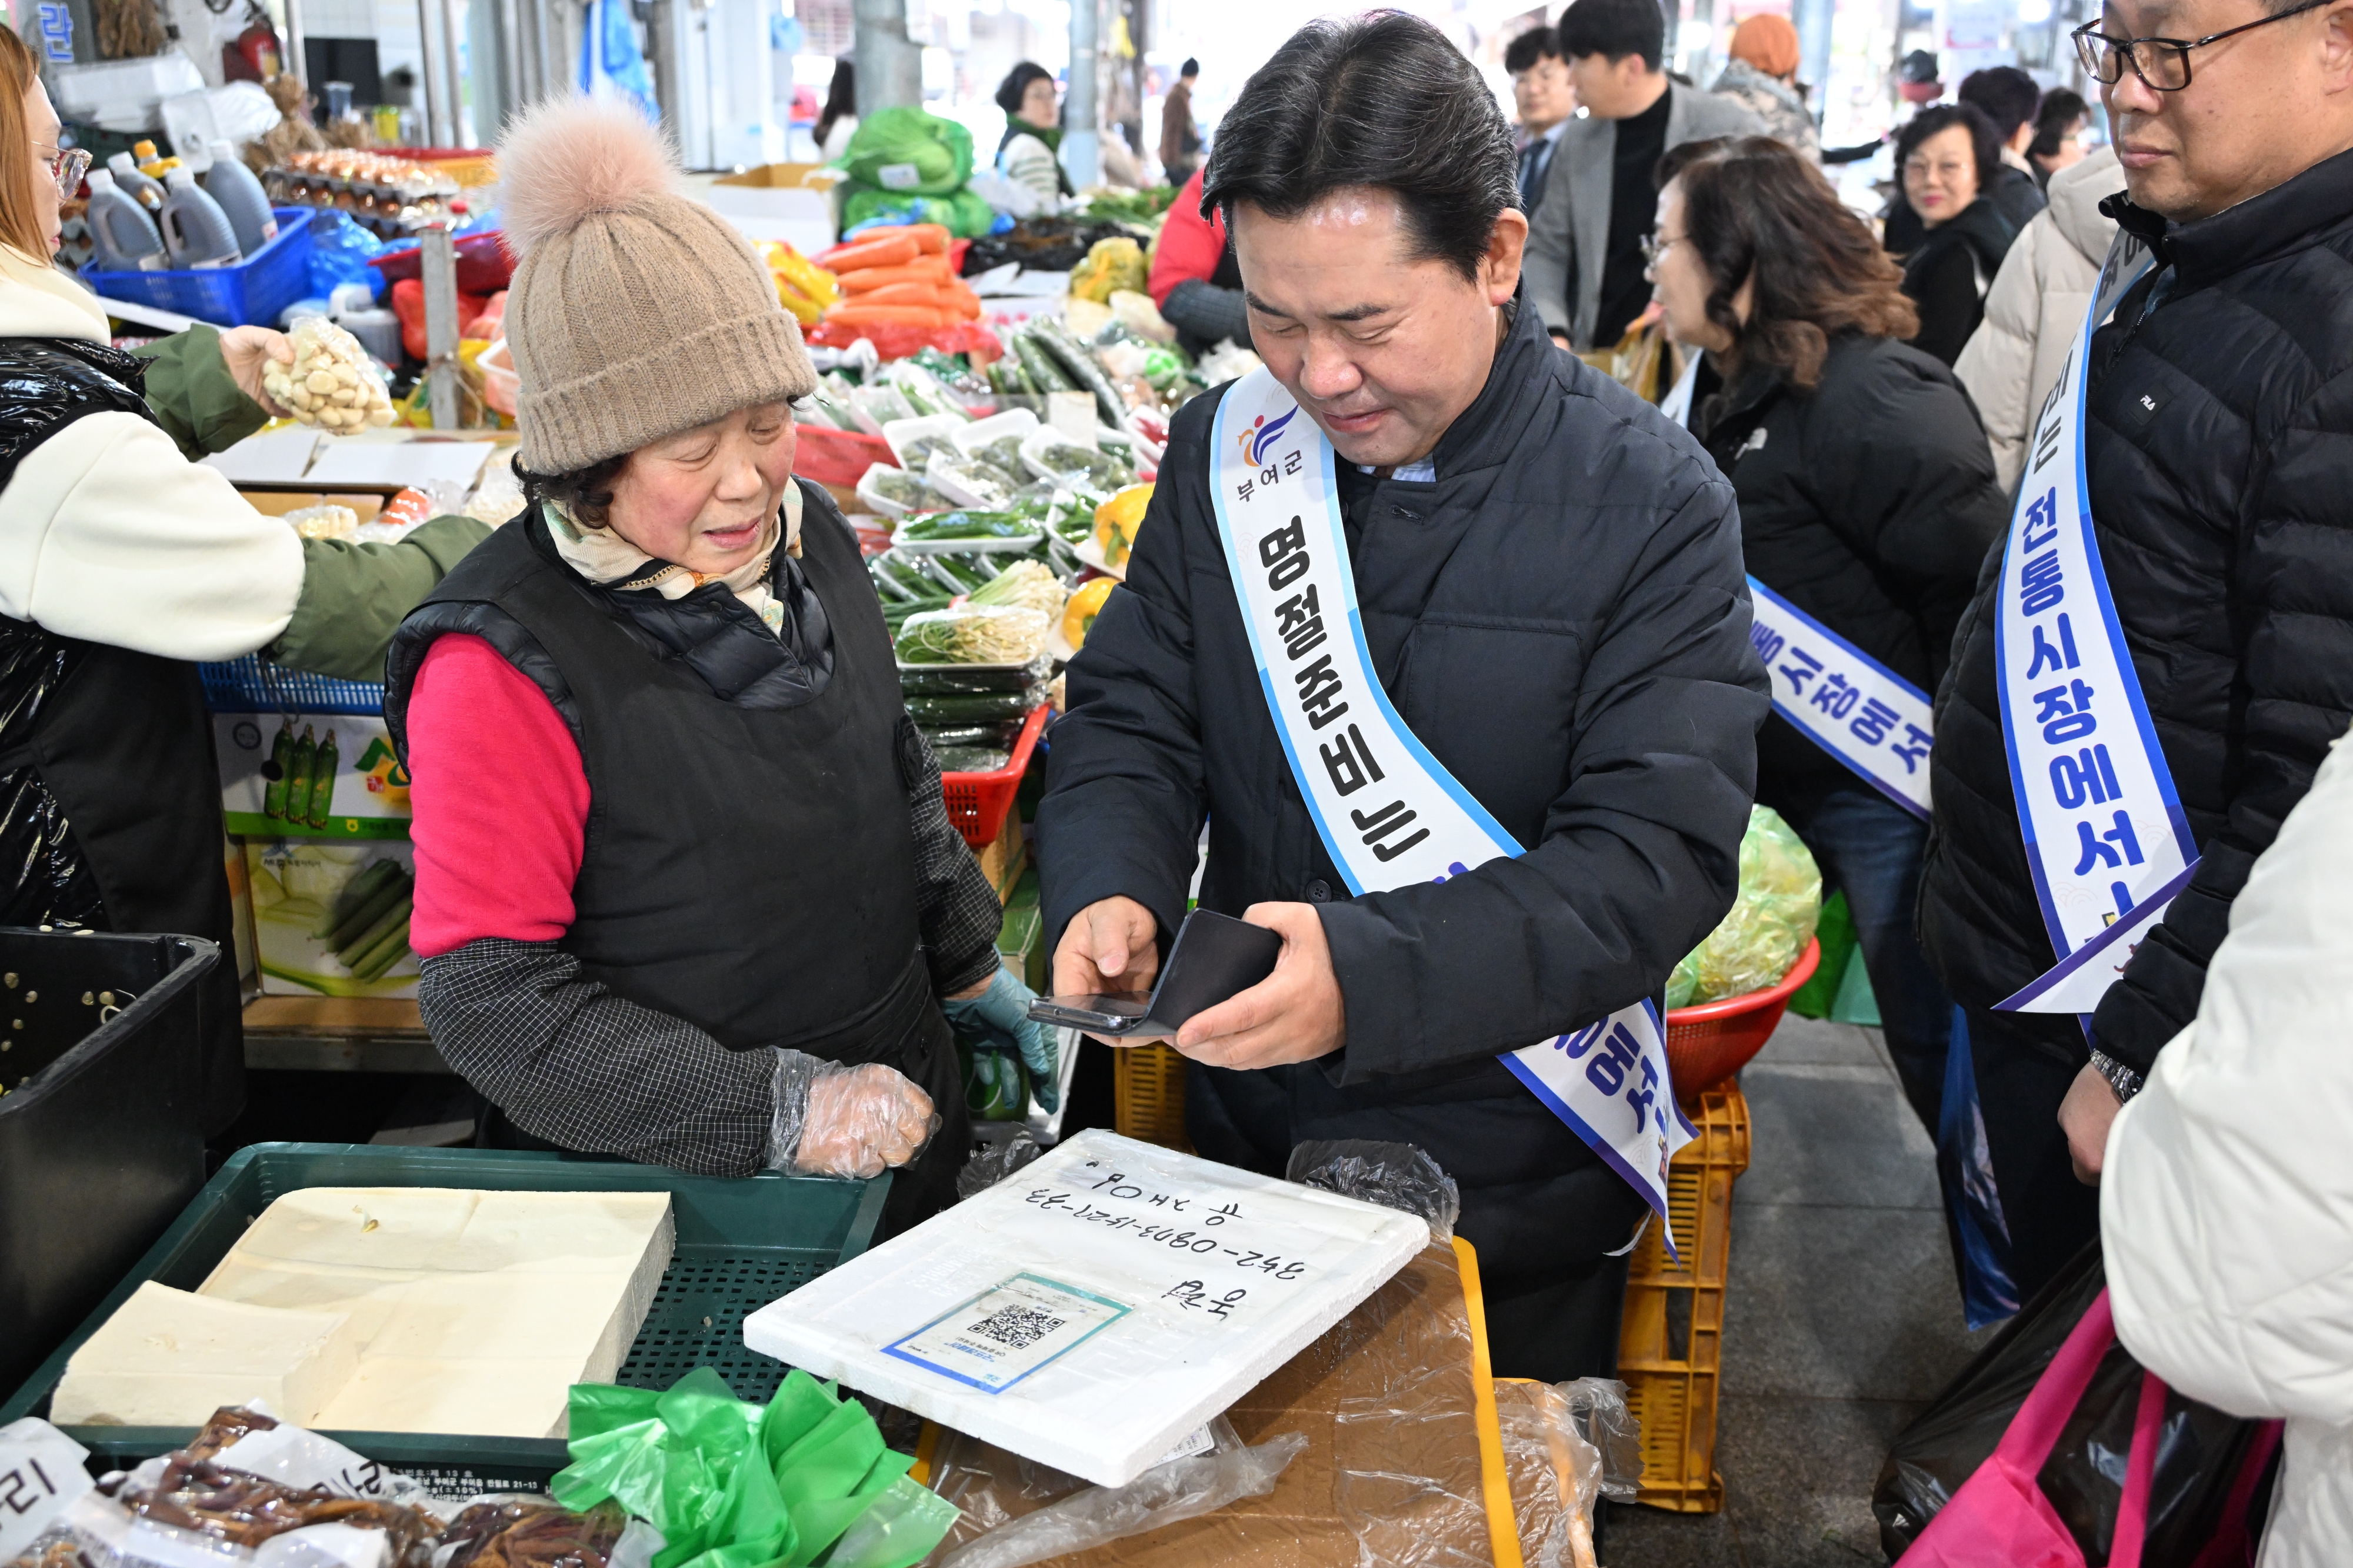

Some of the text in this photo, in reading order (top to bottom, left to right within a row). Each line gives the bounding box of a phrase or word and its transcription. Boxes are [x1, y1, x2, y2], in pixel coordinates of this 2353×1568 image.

[2140, 395, 2155, 411] FILA
[1237, 449, 1302, 502] 부여군
[1258, 515, 1431, 863] 명절준비는
